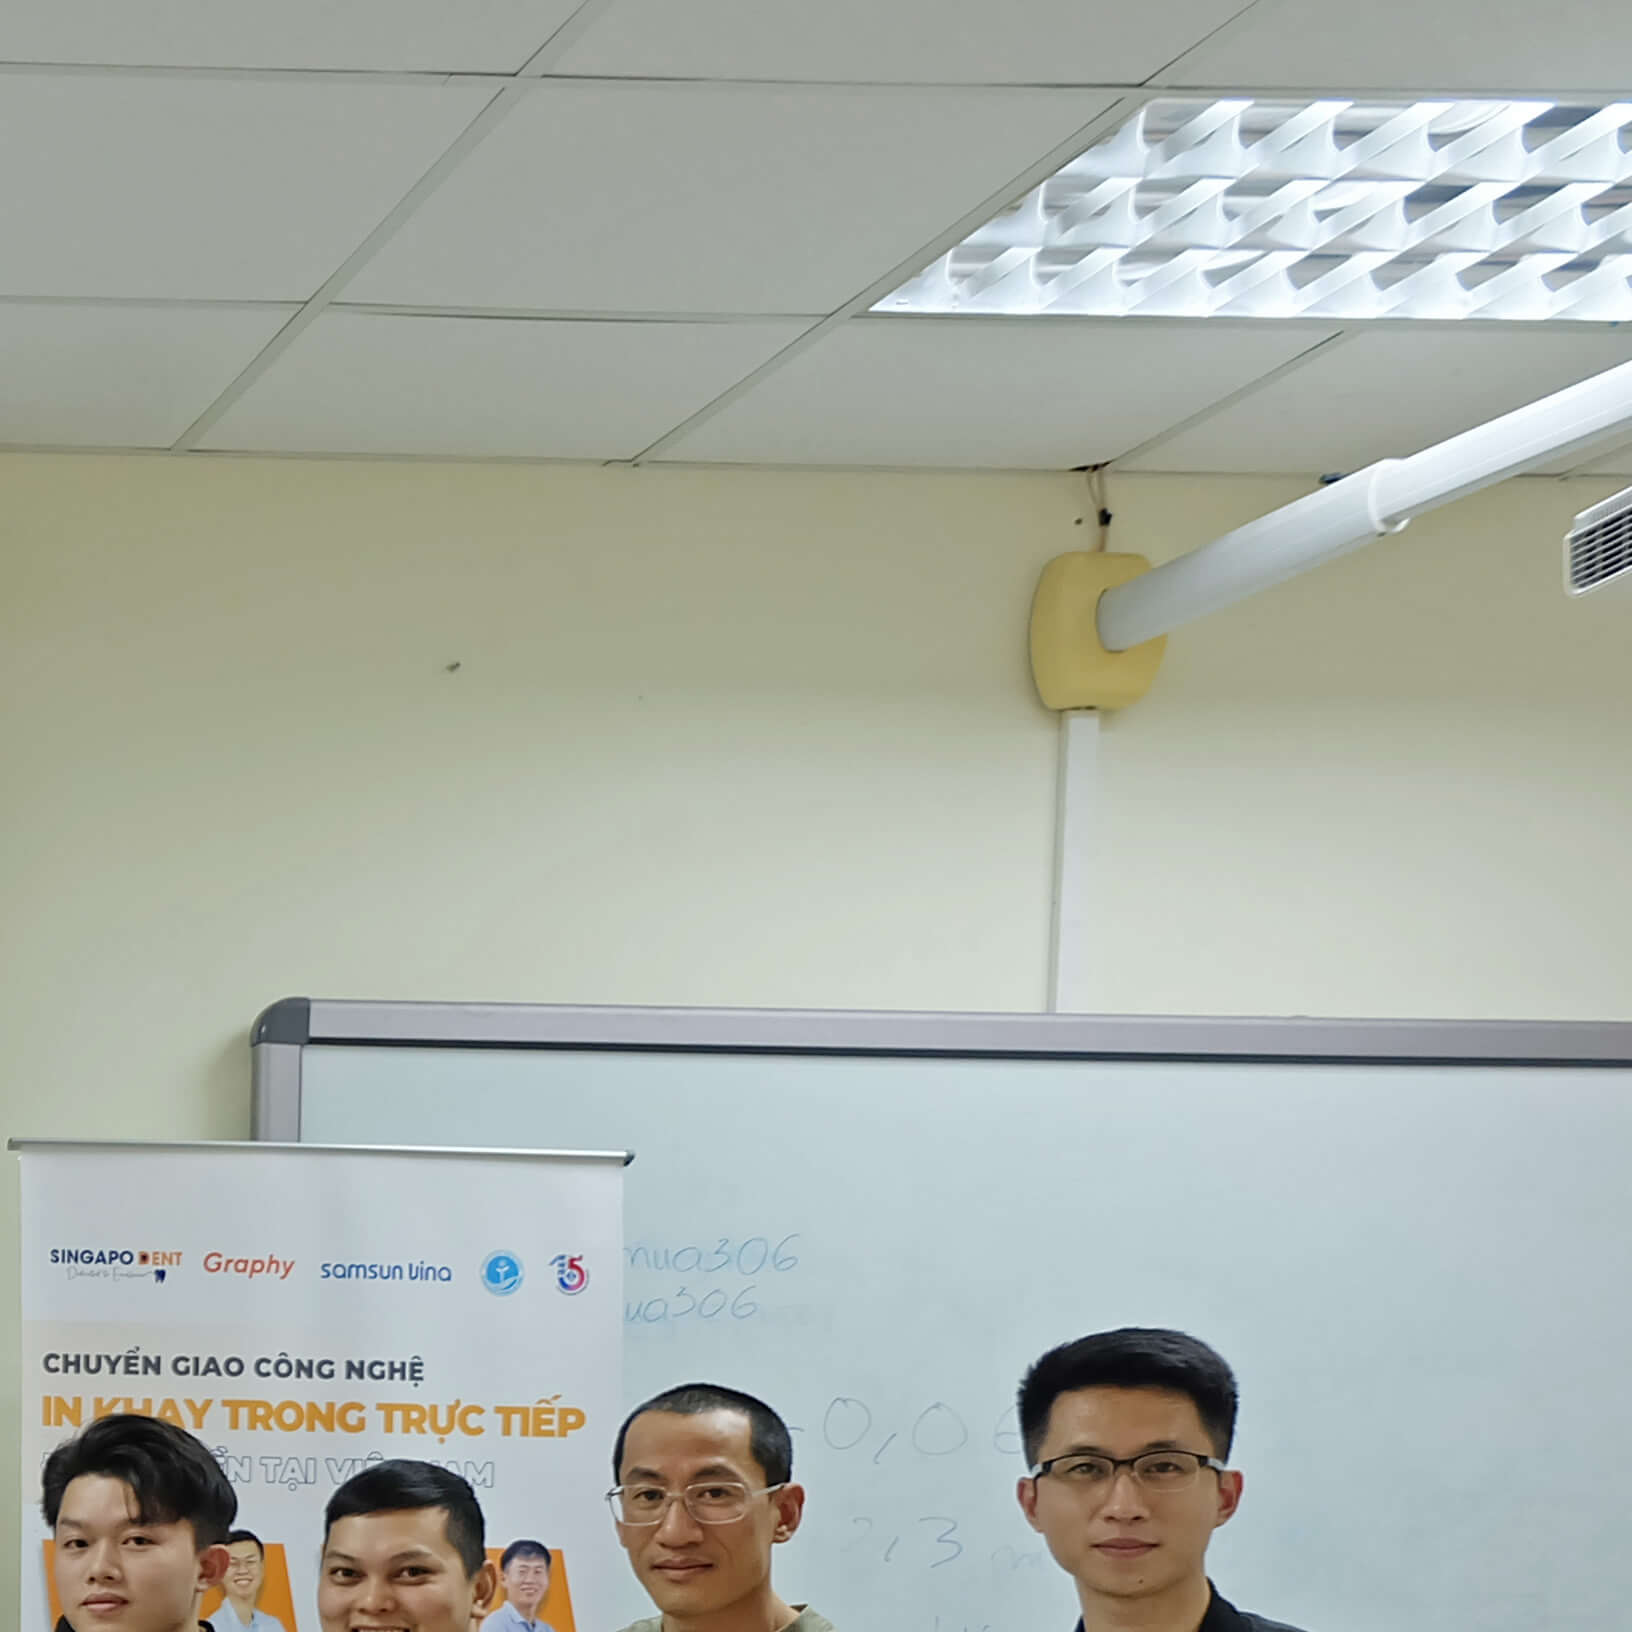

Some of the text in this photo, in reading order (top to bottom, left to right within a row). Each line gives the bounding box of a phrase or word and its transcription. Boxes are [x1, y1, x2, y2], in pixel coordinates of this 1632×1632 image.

[49, 1249, 183, 1267] SINGAPO DENT
[203, 1252, 296, 1280] Graphy
[320, 1262, 403, 1281] samsun
[625, 1285, 758, 1323] ua306
[43, 1345, 424, 1387] CHUYỂN GIAO CÔNG NGHỆ
[41, 1396, 83, 1427] IN
[221, 1399, 367, 1433] TRONG
[375, 1399, 486, 1444] TRỰC
[494, 1394, 587, 1438] TIẾP
[260, 1456, 318, 1491] TẠI
